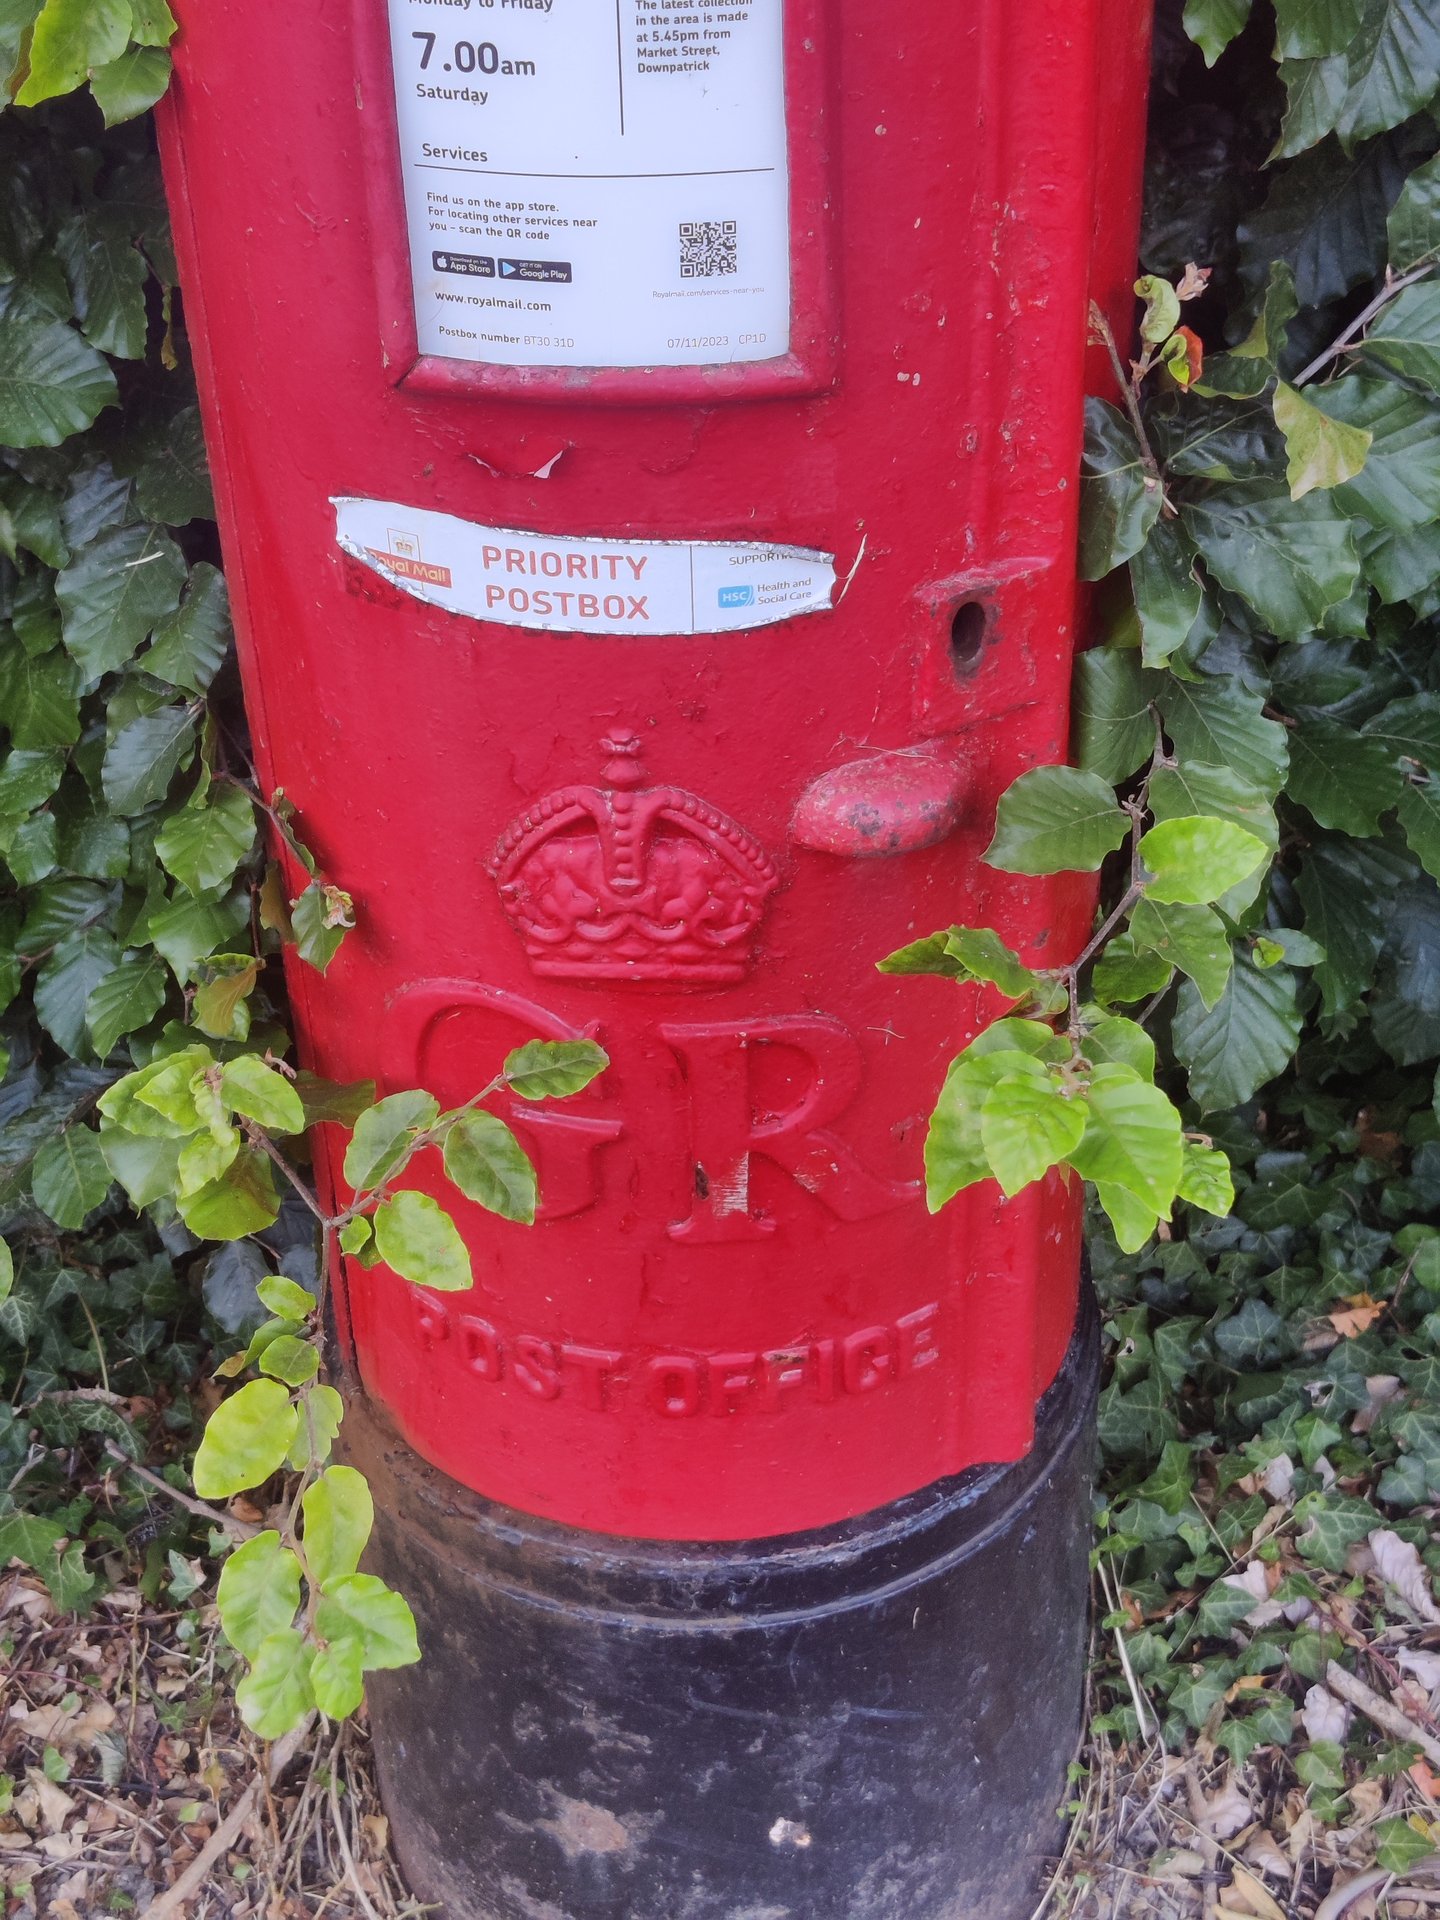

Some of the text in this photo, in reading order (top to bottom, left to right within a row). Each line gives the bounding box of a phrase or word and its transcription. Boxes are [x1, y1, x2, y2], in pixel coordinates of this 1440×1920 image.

[409, 0, 553, 13] onday to Friday
[635, 0, 657, 10] The
[661, 0, 694, 9] latest
[635, 11, 748, 26] in the area is made
[636, 29, 731, 43] at 5.45pm from
[411, 31, 536, 75] 7.00am
[637, 45, 720, 58] Market Street,
[637, 60, 710, 74] Downpatrick
[416, 83, 489, 106] Saturday
[422, 143, 488, 162] Services
[426, 191, 560, 212] Find us on the app store.
[428, 206, 598, 227] For locating other services near
[429, 221, 448, 231] you
[458, 225, 482, 235] scan
[485, 227, 503, 237] the
[506, 228, 522, 239] QR
[525, 230, 550, 240] code
[450, 261, 491, 274] App Store
[519, 268, 568, 281] Google Play
[435, 291, 551, 312] www.royalmail.com
[439, 325, 575, 348] Postbox number BT30 31D
[667, 333, 767, 349] 07/11/2023 CP1D
[482, 545, 648, 581] PRIORITY
[413, 563, 446, 582] Mail
[757, 577, 813, 592] Health and
[485, 584, 650, 621] POSTBOX
[722, 590, 748, 603] HSC
[758, 591, 812, 606] Social Care
[408, 1283, 940, 1418] POST OFFICE
